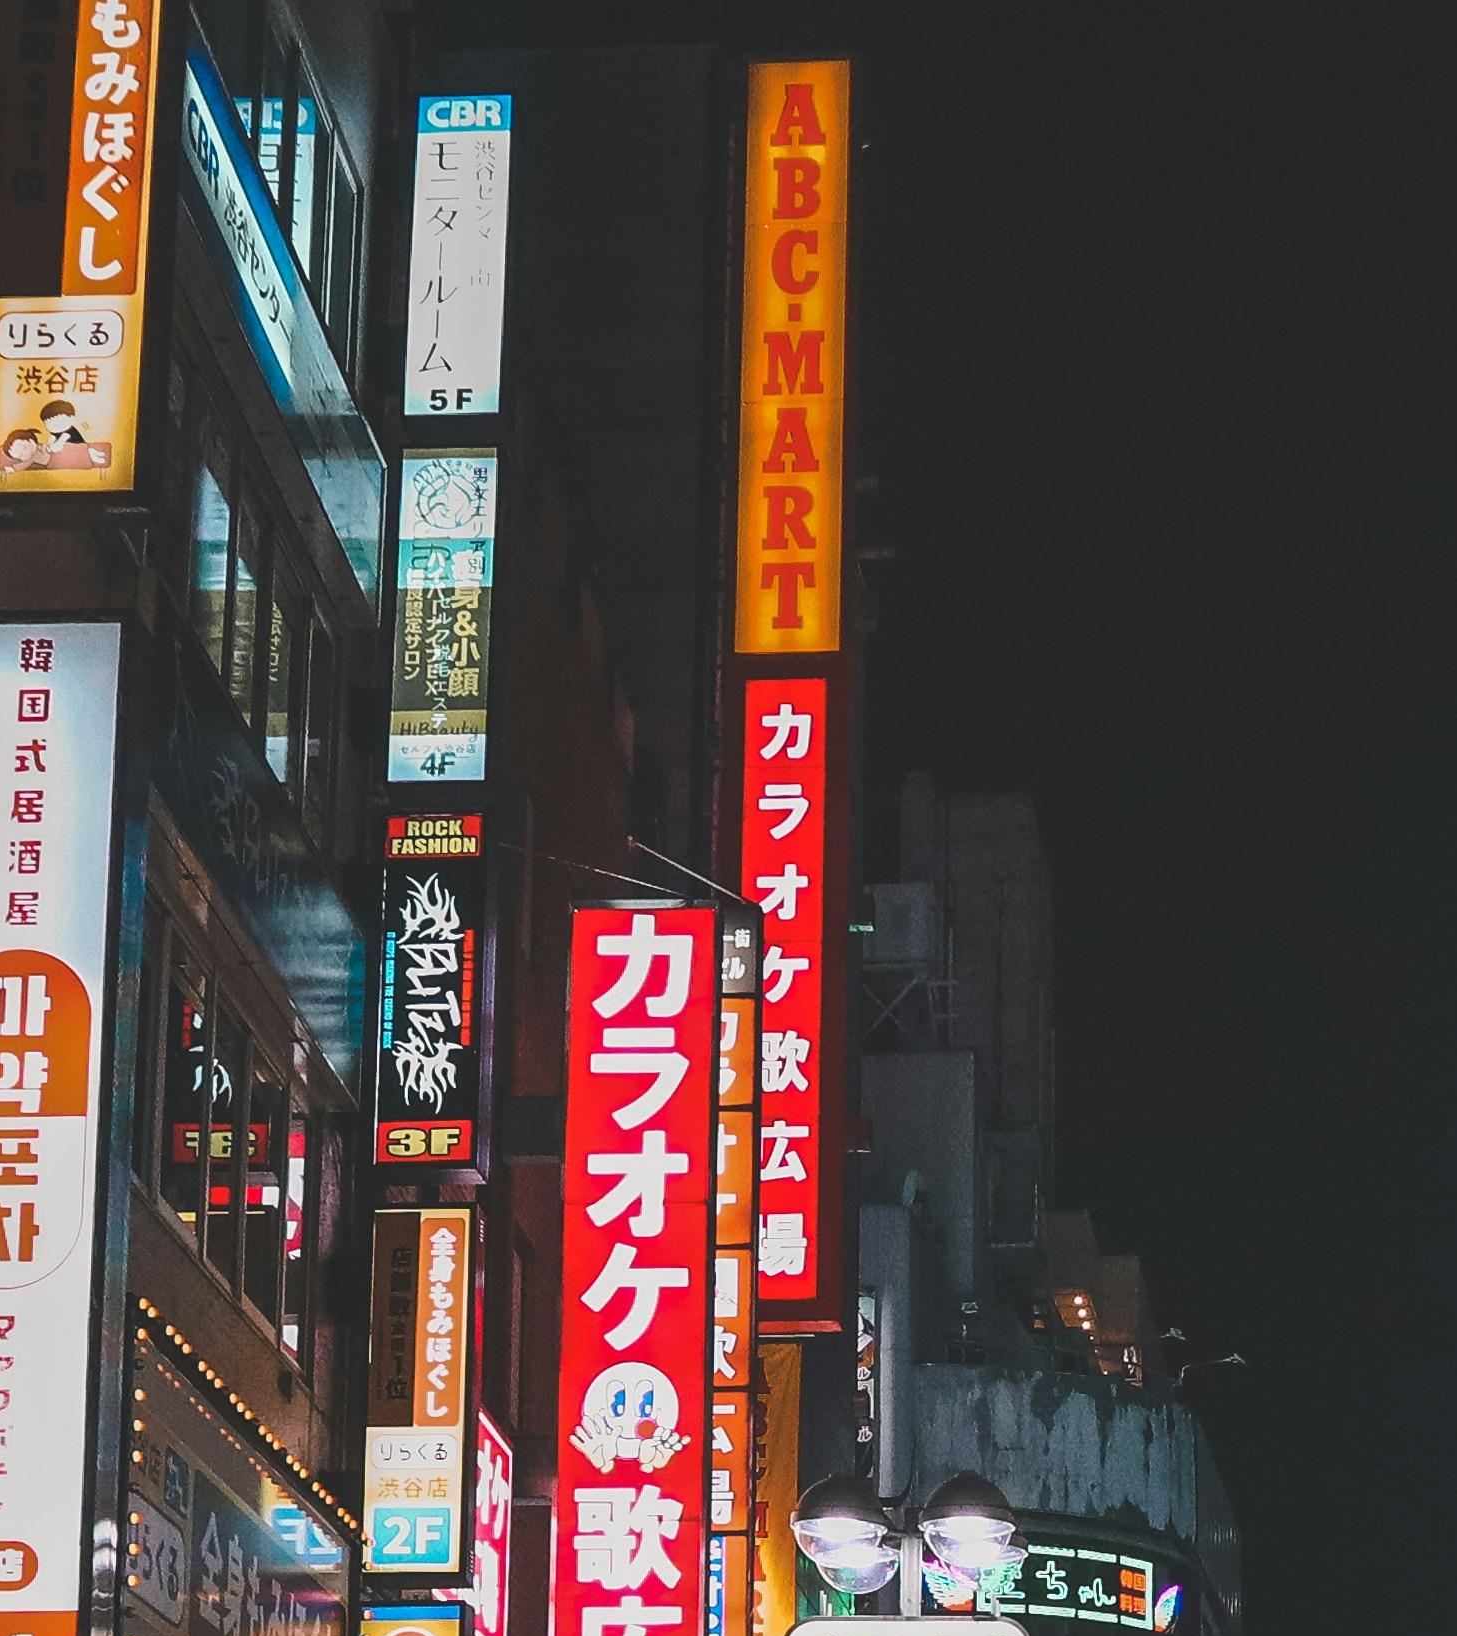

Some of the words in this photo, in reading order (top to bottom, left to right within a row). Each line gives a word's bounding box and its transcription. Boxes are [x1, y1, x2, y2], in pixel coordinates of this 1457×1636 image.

[427, 99, 503, 129] CBR
[78, 0, 143, 282] もみほぐし
[418, 141, 463, 374] モニタールーム
[6, 320, 112, 350] りらくる
[15, 366, 99, 394] 渋谷店
[429, 388, 474, 412] 5F
[446, 549, 483, 697] 身&小顔
[4, 638, 54, 927] 韓国式居酒屋
[407, 819, 464, 836] ROCK
[390, 836, 477, 856] FASHION
[757, 702, 814, 1277] カラオケ歌広場
[387, 1127, 461, 1158] 3F
[579, 914, 694, 1352] カラオケ
[425, 1227, 459, 1420] 全身もみほぐし
[379, 1440, 450, 1464] りらくる
[377, 1476, 449, 1499] 渋谷店
[382, 1514, 445, 1557] 2F
